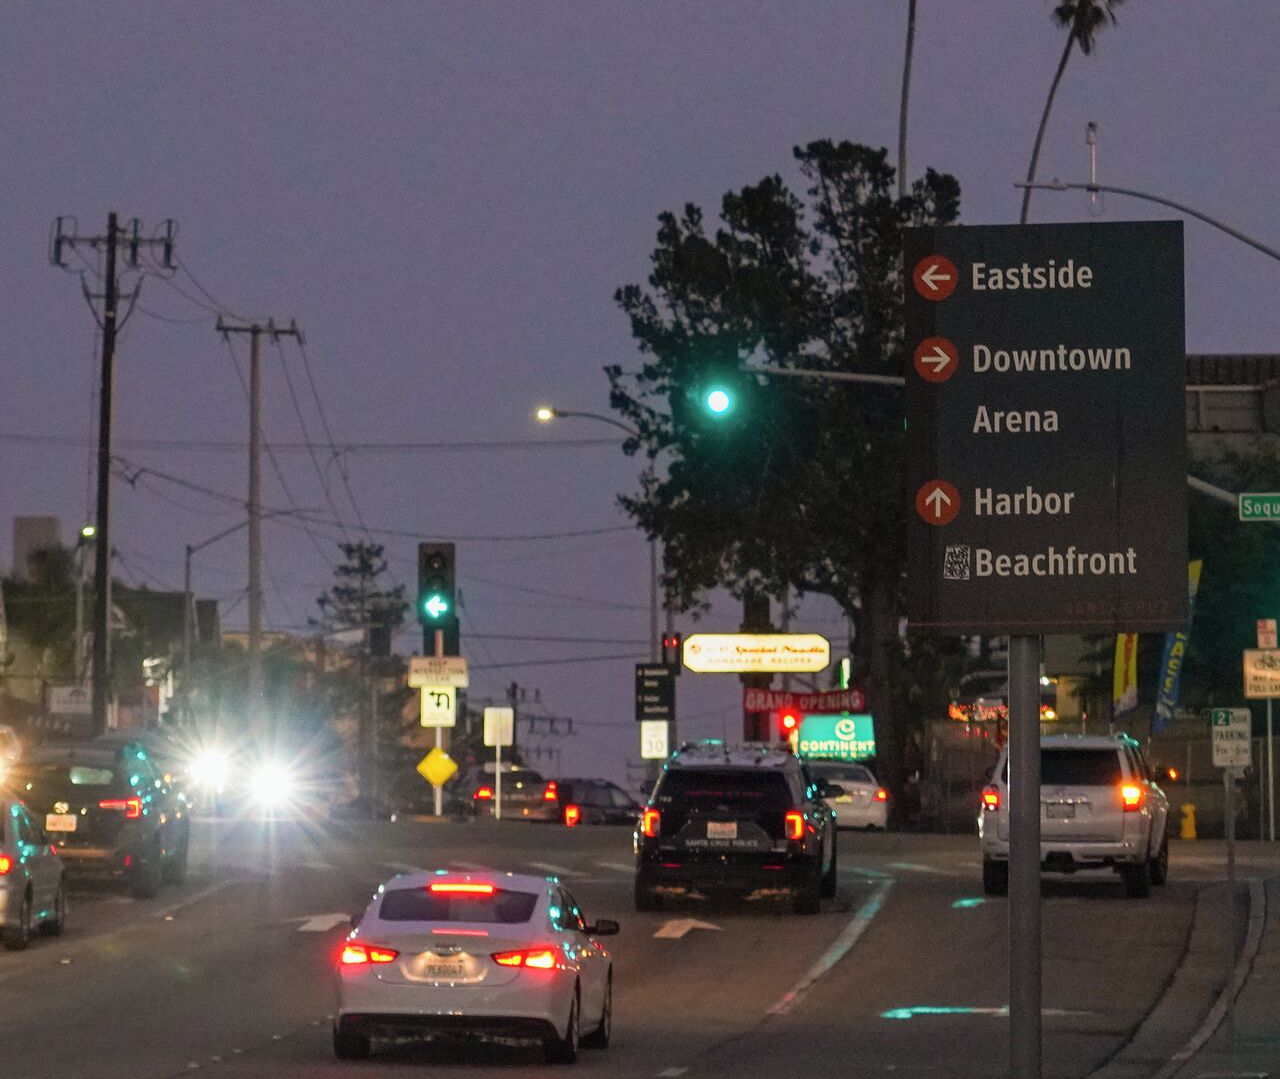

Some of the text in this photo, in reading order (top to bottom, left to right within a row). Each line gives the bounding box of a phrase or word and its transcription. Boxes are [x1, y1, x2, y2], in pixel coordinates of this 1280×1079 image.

[972, 260, 1093, 290] Eastside
[973, 345, 1131, 372] Downtown
[972, 406, 1059, 433] Arena
[974, 486, 1075, 516] Harbor
[975, 546, 1137, 577] Beachfront
[744, 689, 862, 712] GRAND OPENING
